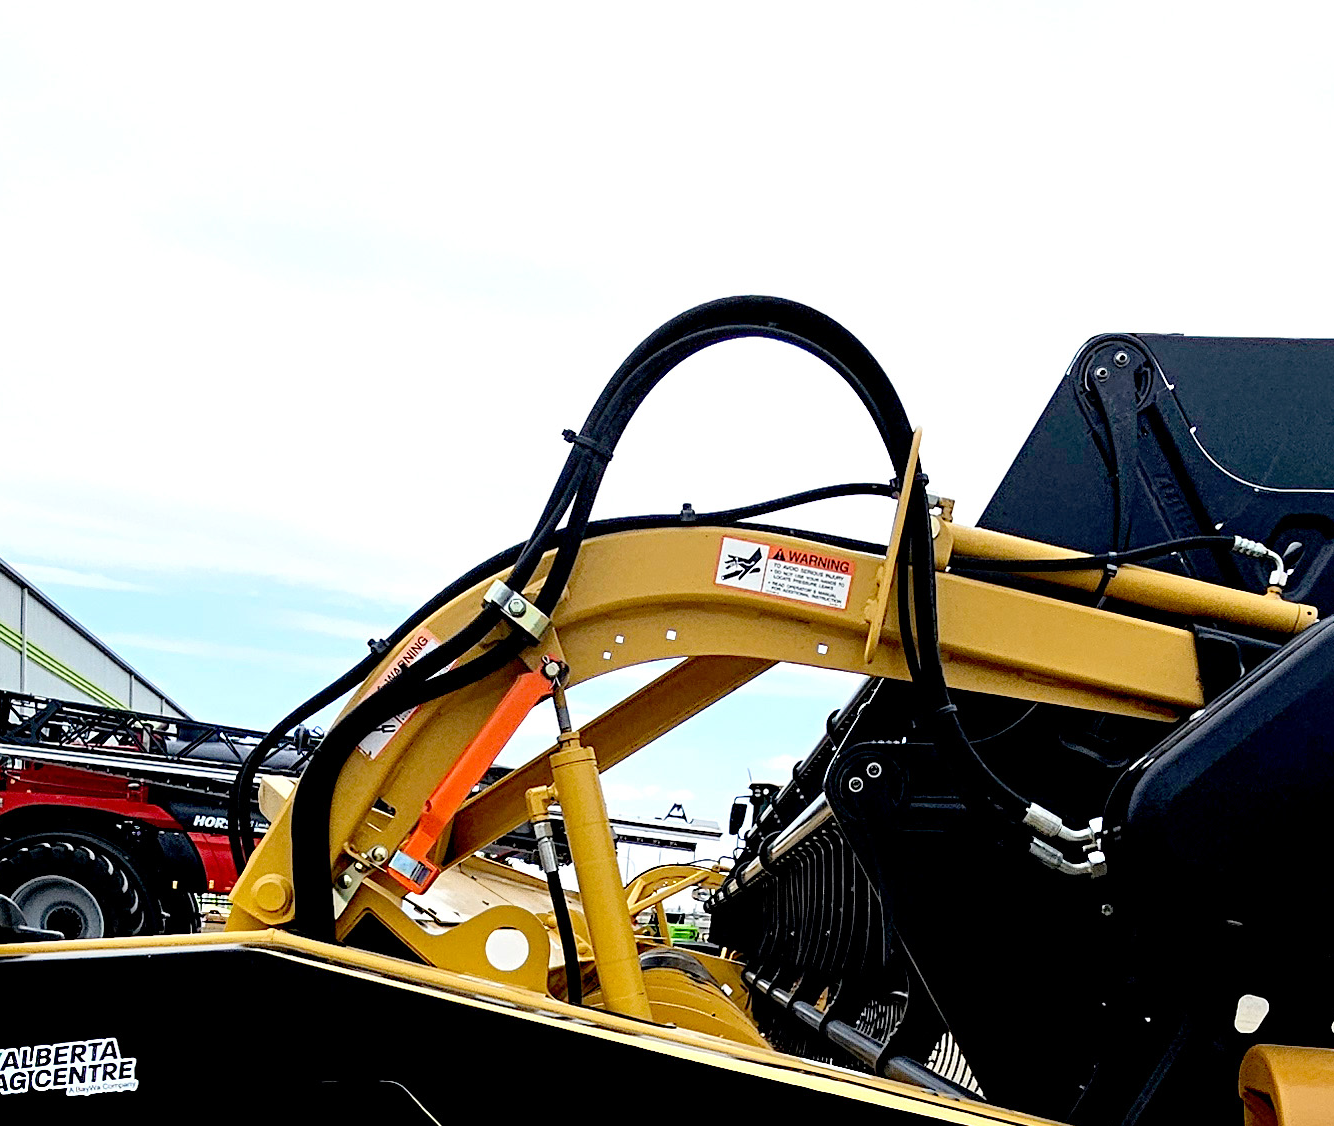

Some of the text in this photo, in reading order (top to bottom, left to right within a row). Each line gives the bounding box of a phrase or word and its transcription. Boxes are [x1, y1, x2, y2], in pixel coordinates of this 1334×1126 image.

[788, 551, 850, 573] WARNING
[801, 568, 823, 577] SERIOUS
[825, 573, 844, 581] INJURY
[0, 1040, 119, 1071] ALBERTA
[34, 1061, 133, 1089] CENTRE
[76, 1084, 101, 1094] BayWa
[103, 1081, 137, 1092] Company
